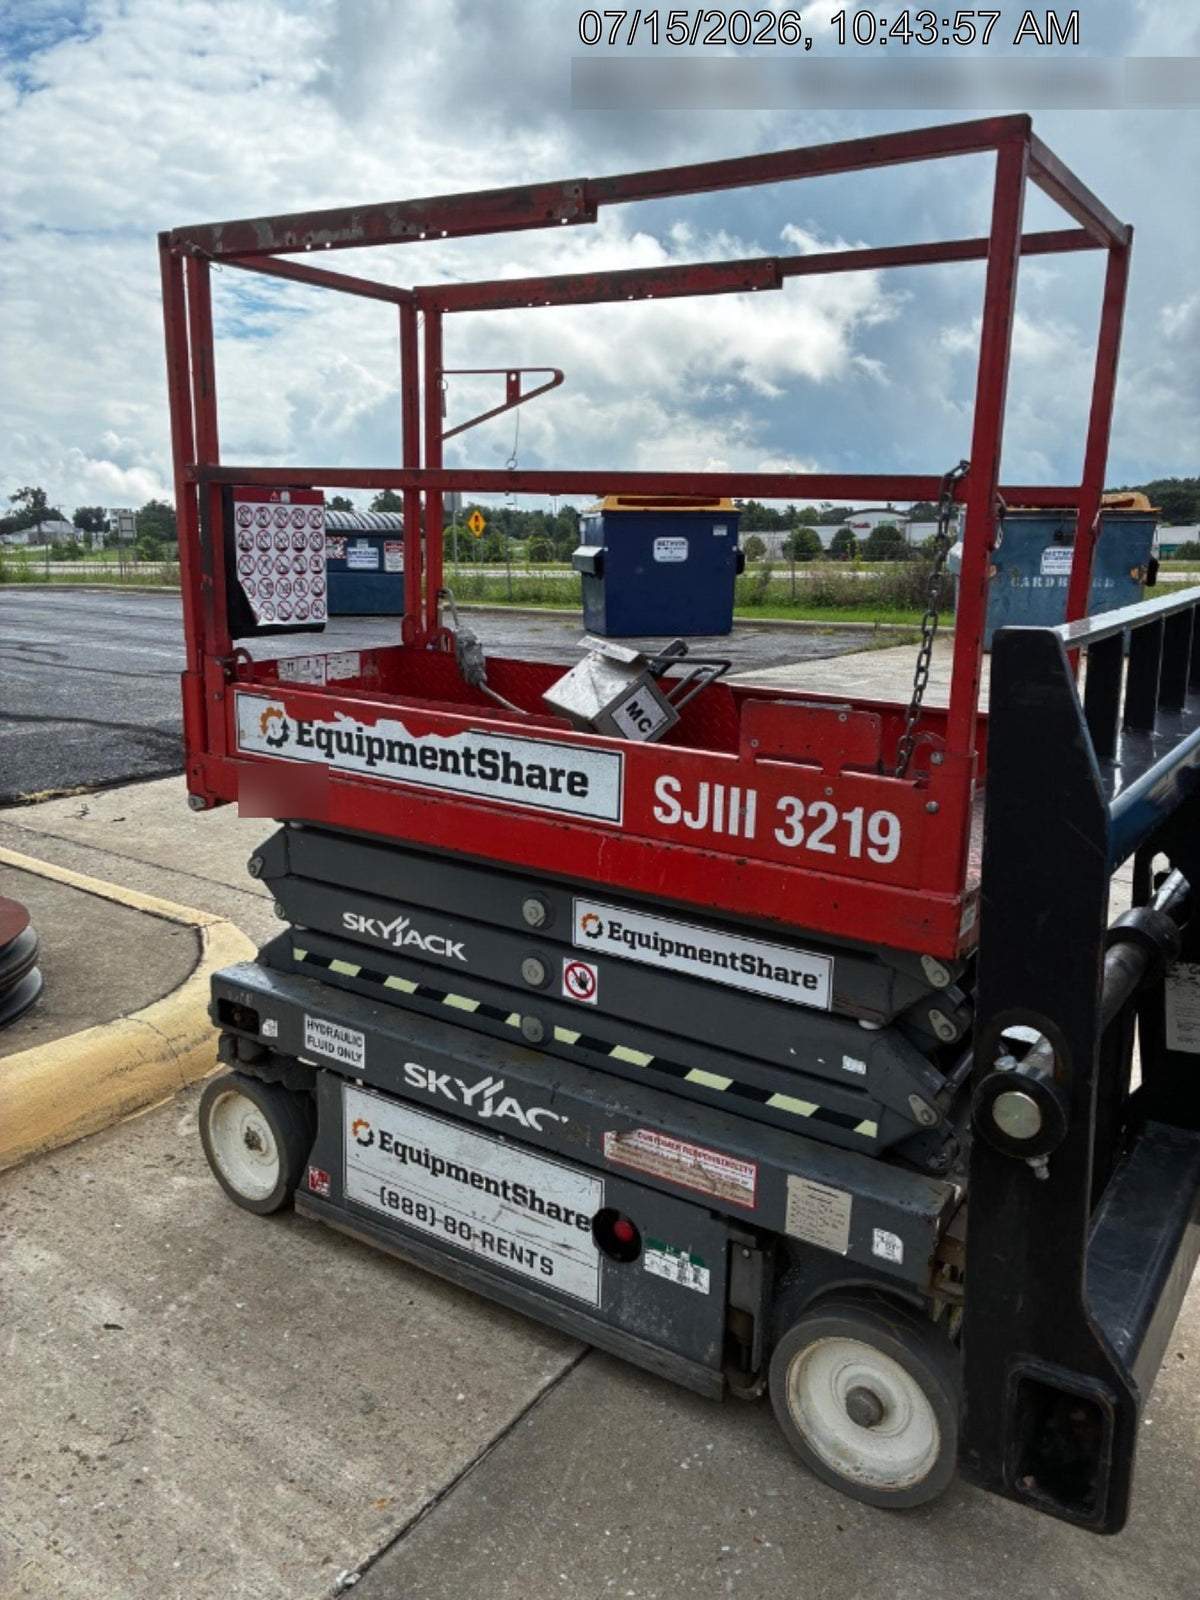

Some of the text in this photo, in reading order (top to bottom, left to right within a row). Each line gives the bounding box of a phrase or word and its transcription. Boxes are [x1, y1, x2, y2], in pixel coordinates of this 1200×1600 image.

[625, 701, 653, 733] MC
[296, 721, 589, 798] EquipmentShare
[653, 774, 901, 864] SJIII 3219
[342, 911, 468, 962] SKYJACK
[608, 920, 818, 992] EquipmentShare
[306, 1019, 363, 1048] HYDRAULIC
[307, 1034, 363, 1062] FLUID ONLY
[404, 1062, 569, 1132] SKYJAC
[378, 1129, 594, 1234] EquipmentShare
[379, 1185, 555, 1278] (888)-80-RENTS
